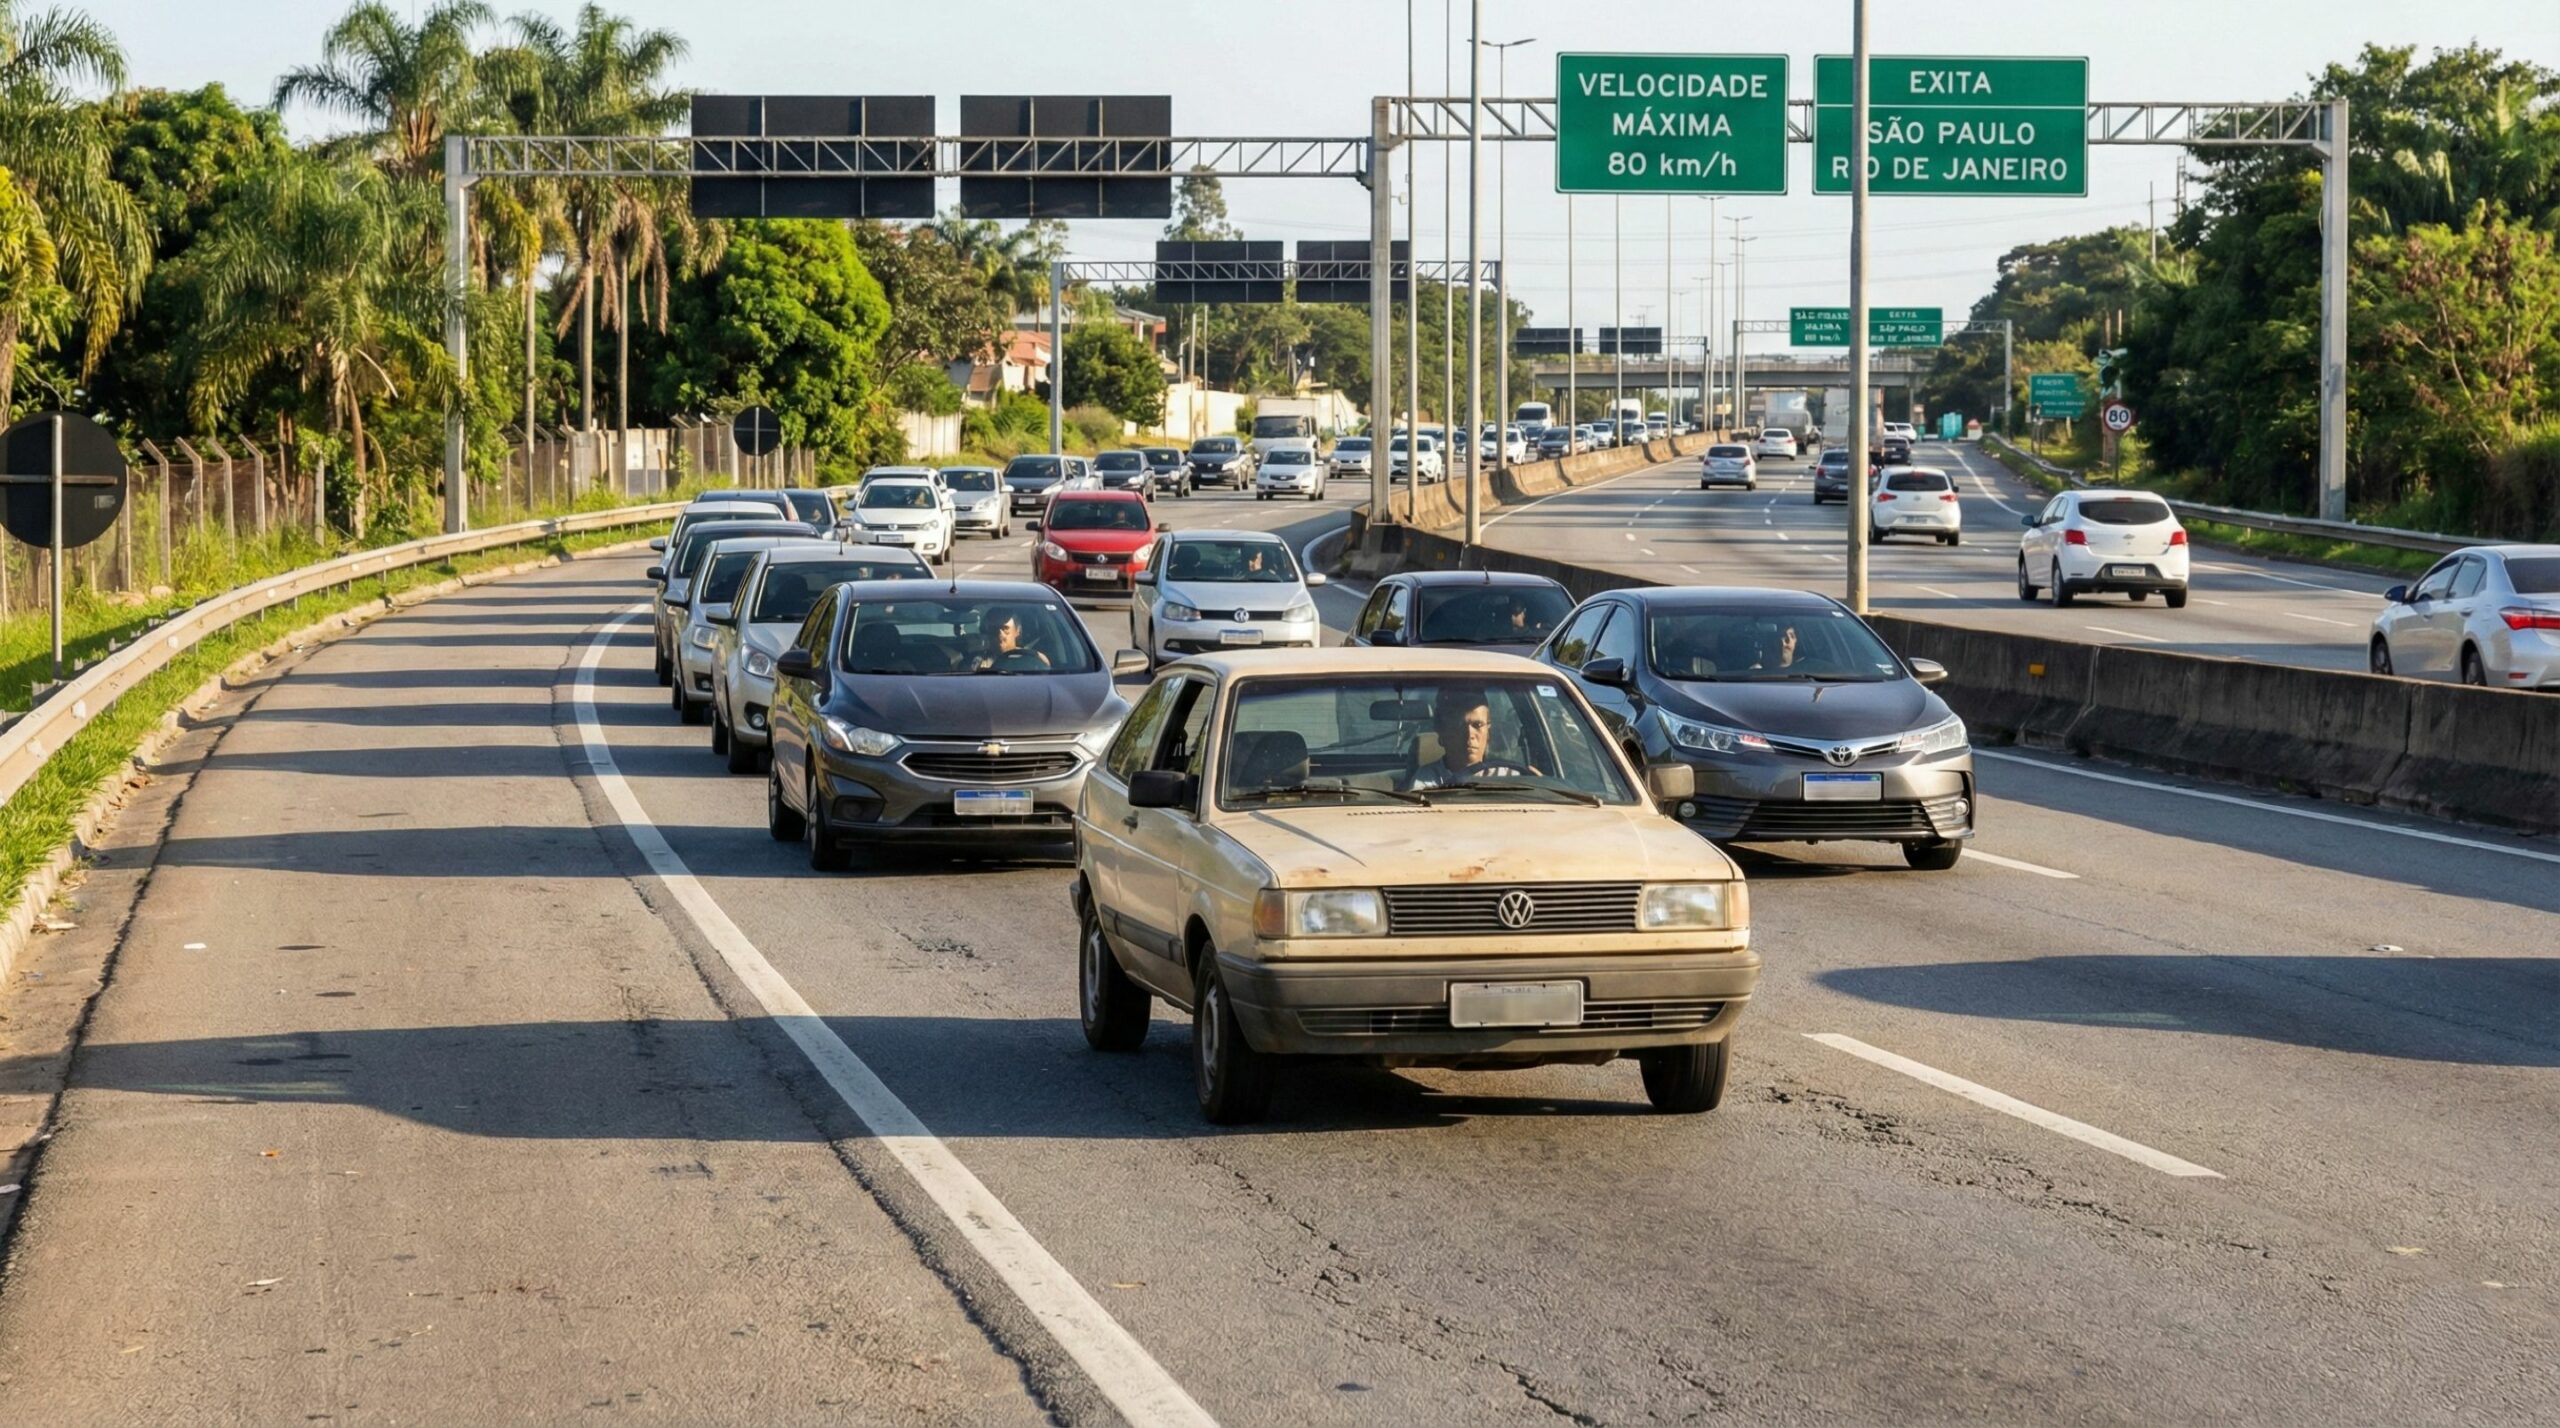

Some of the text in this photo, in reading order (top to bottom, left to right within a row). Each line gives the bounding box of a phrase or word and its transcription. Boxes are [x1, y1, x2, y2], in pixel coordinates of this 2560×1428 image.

[1578, 73, 1768, 98] VELOCIDADE
[1910, 71, 1992, 94] EXITA
[1612, 106, 1732, 137] MÁXIMA
[1868, 115, 2036, 145] SÃO PAULO
[1607, 150, 1737, 177] 80 km/h
[1832, 156, 2068, 181] RO DE JANEIRO
[2108, 409, 2130, 423] 80
